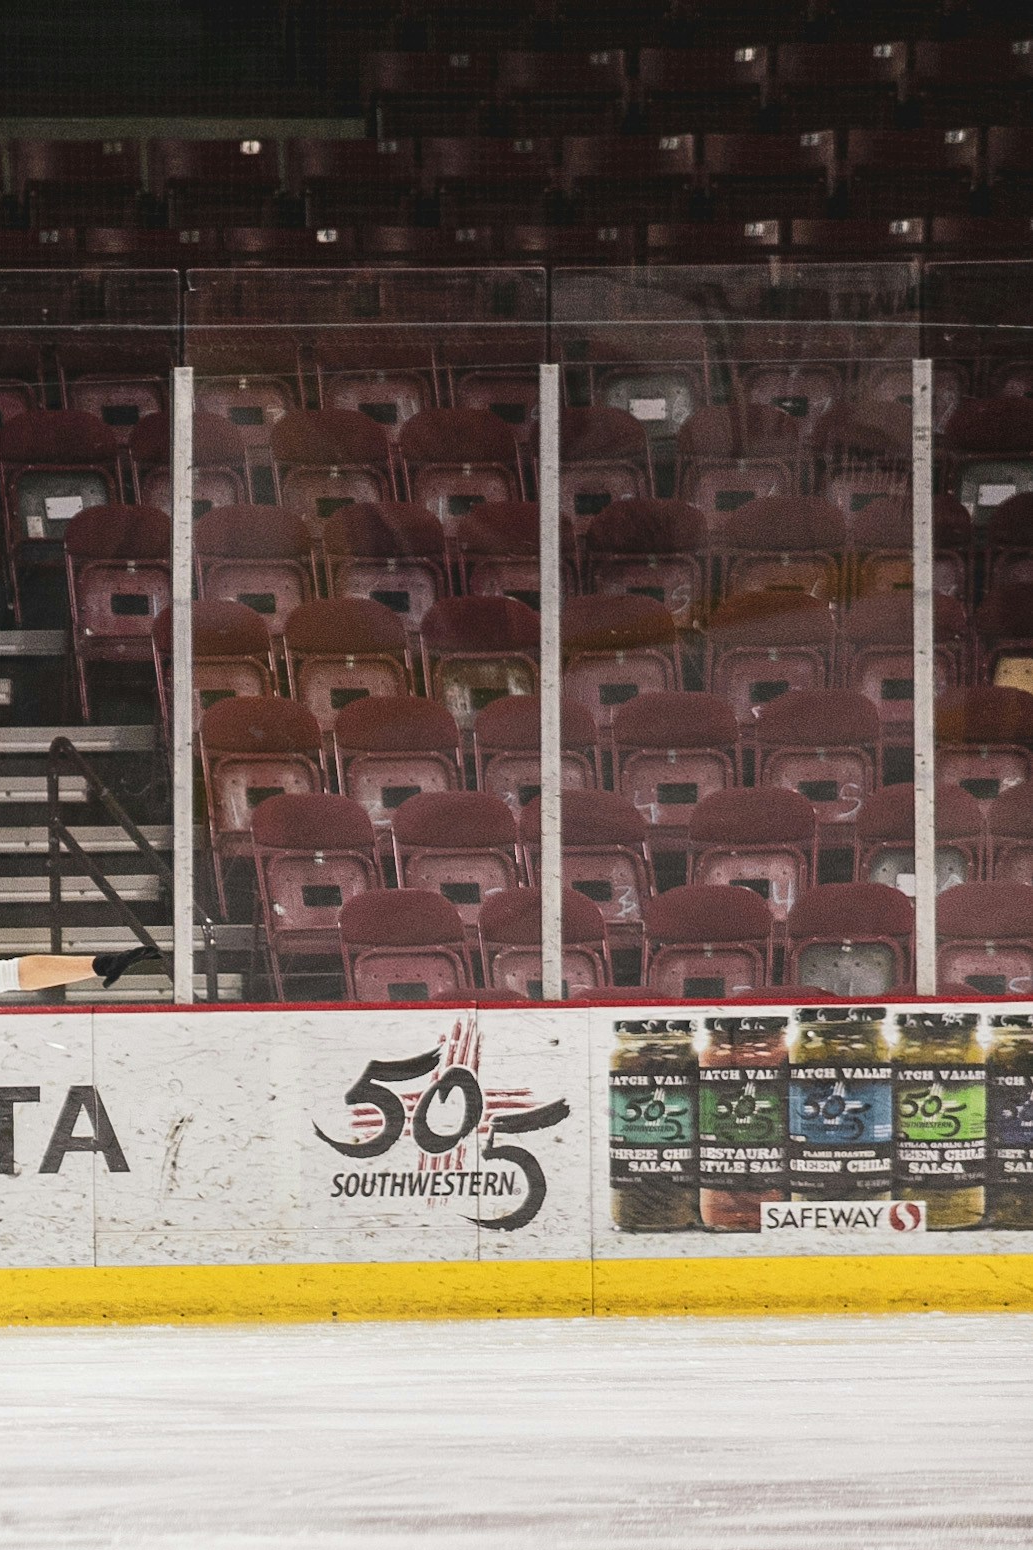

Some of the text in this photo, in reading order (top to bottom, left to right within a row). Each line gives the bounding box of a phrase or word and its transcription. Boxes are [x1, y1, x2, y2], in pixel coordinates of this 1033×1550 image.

[897, 1070, 934, 1080] ATCH
[311, 1045, 571, 1232] 505
[699, 1147, 784, 1160] RESTAURA
[833, 1150, 876, 1158] ROASTED
[944, 1148, 985, 1161] CHILE
[628, 1161, 683, 1173] SALSA
[699, 1160, 785, 1173] STYLE SAL
[789, 1158, 891, 1173] GREEN CHILE
[908, 1162, 965, 1174] SALSA
[1003, 1161, 1033, 1173] SAL
[330, 1171, 516, 1198] SOUTHWESTERN
[767, 1208, 883, 1229] SAFEWAY
